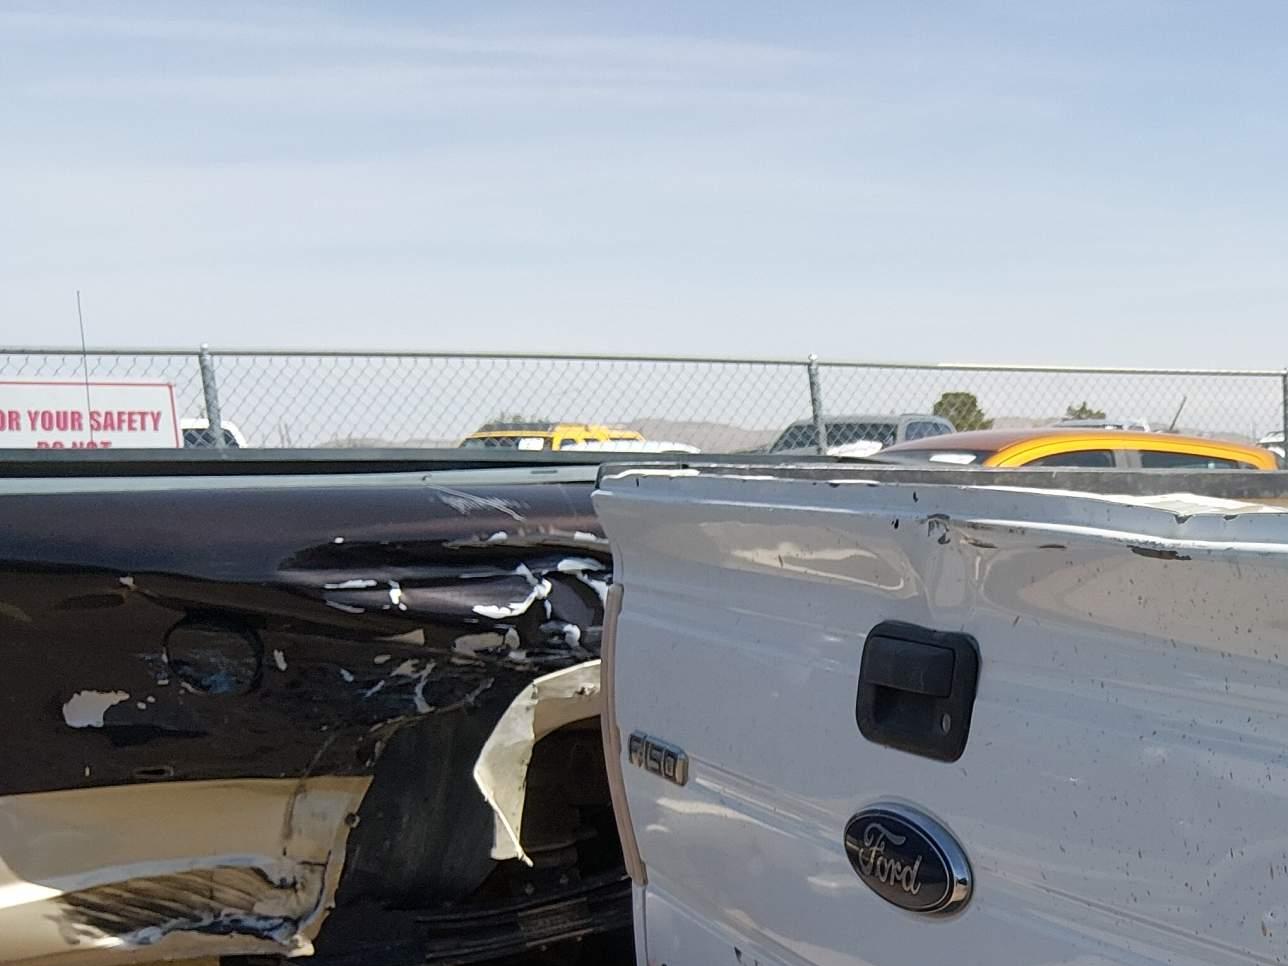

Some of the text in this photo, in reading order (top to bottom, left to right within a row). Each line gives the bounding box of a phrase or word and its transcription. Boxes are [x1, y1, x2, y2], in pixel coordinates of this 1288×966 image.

[27, 409, 84, 432] YOUR
[90, 410, 162, 432] SAFETY
[858, 823, 922, 895] Ford
